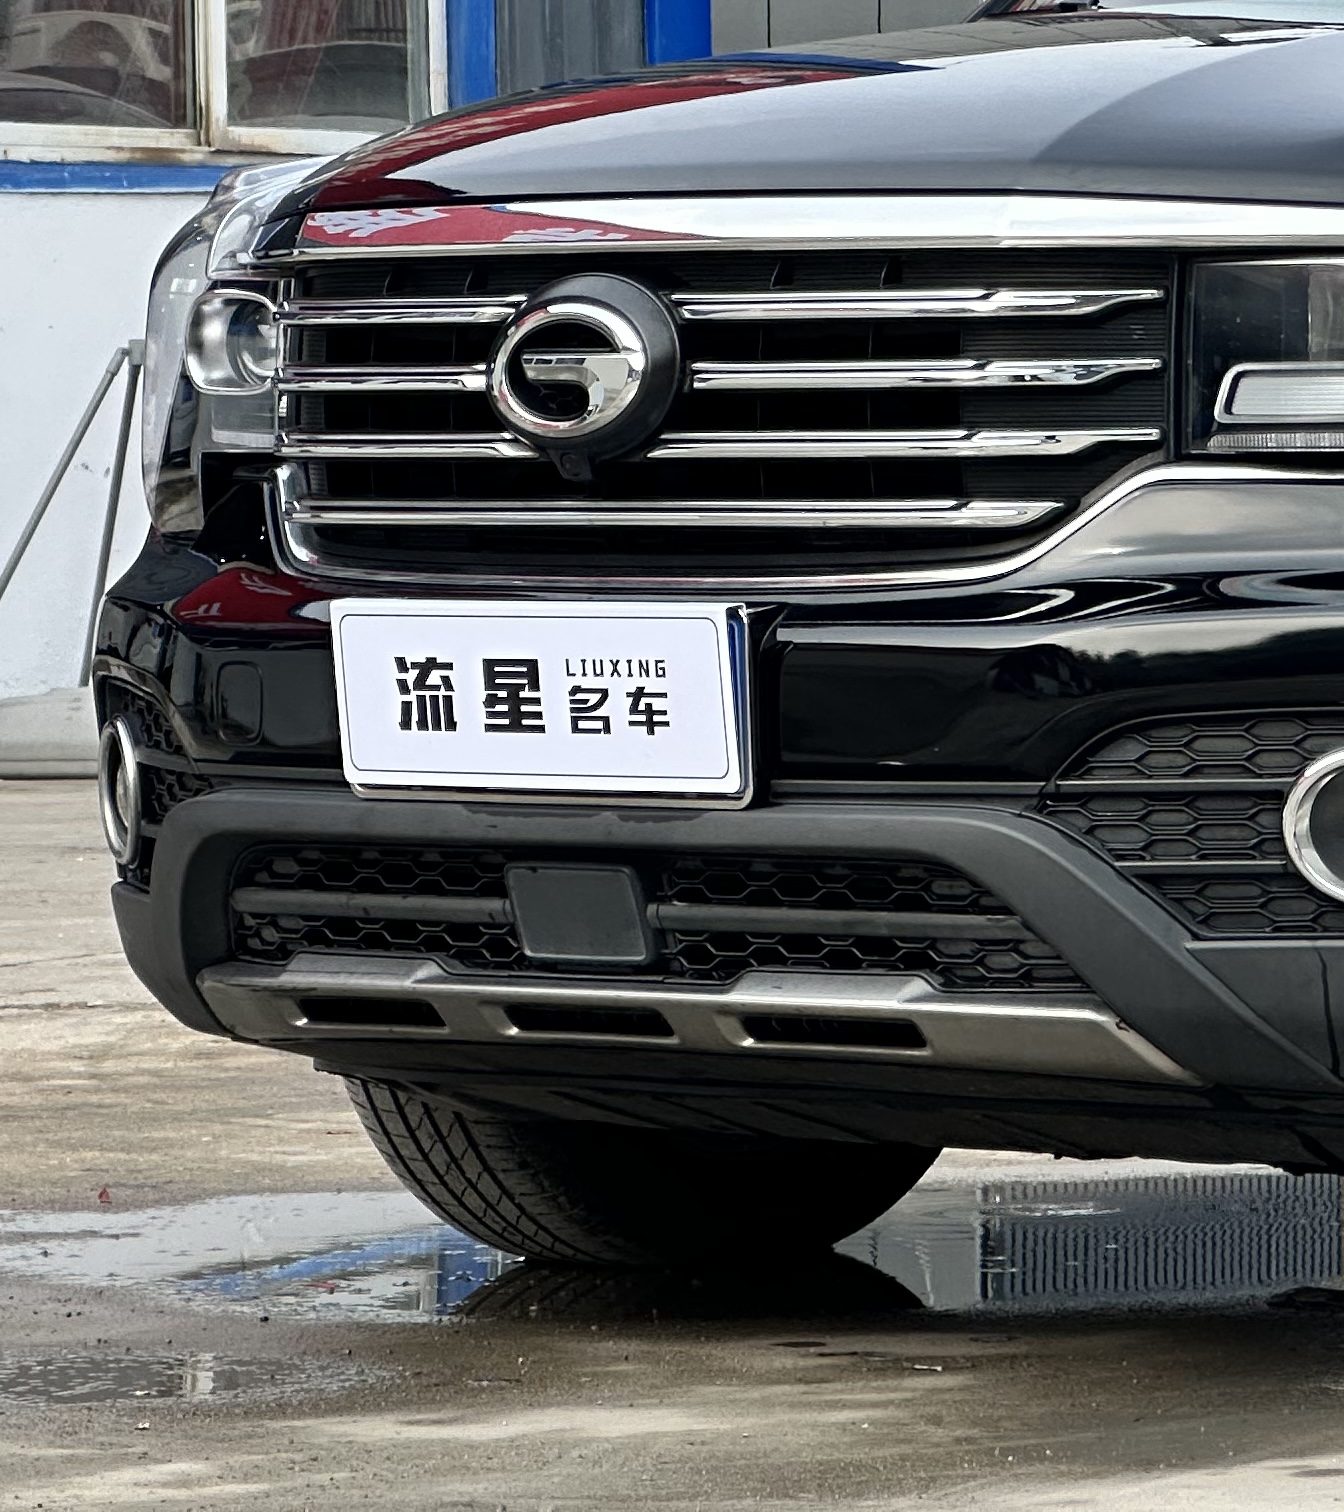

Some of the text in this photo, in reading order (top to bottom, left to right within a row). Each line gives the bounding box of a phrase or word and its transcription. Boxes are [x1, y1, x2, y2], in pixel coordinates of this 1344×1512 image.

[565, 658, 666, 678] LIUXING
[394, 656, 670, 736] 流星 名车
